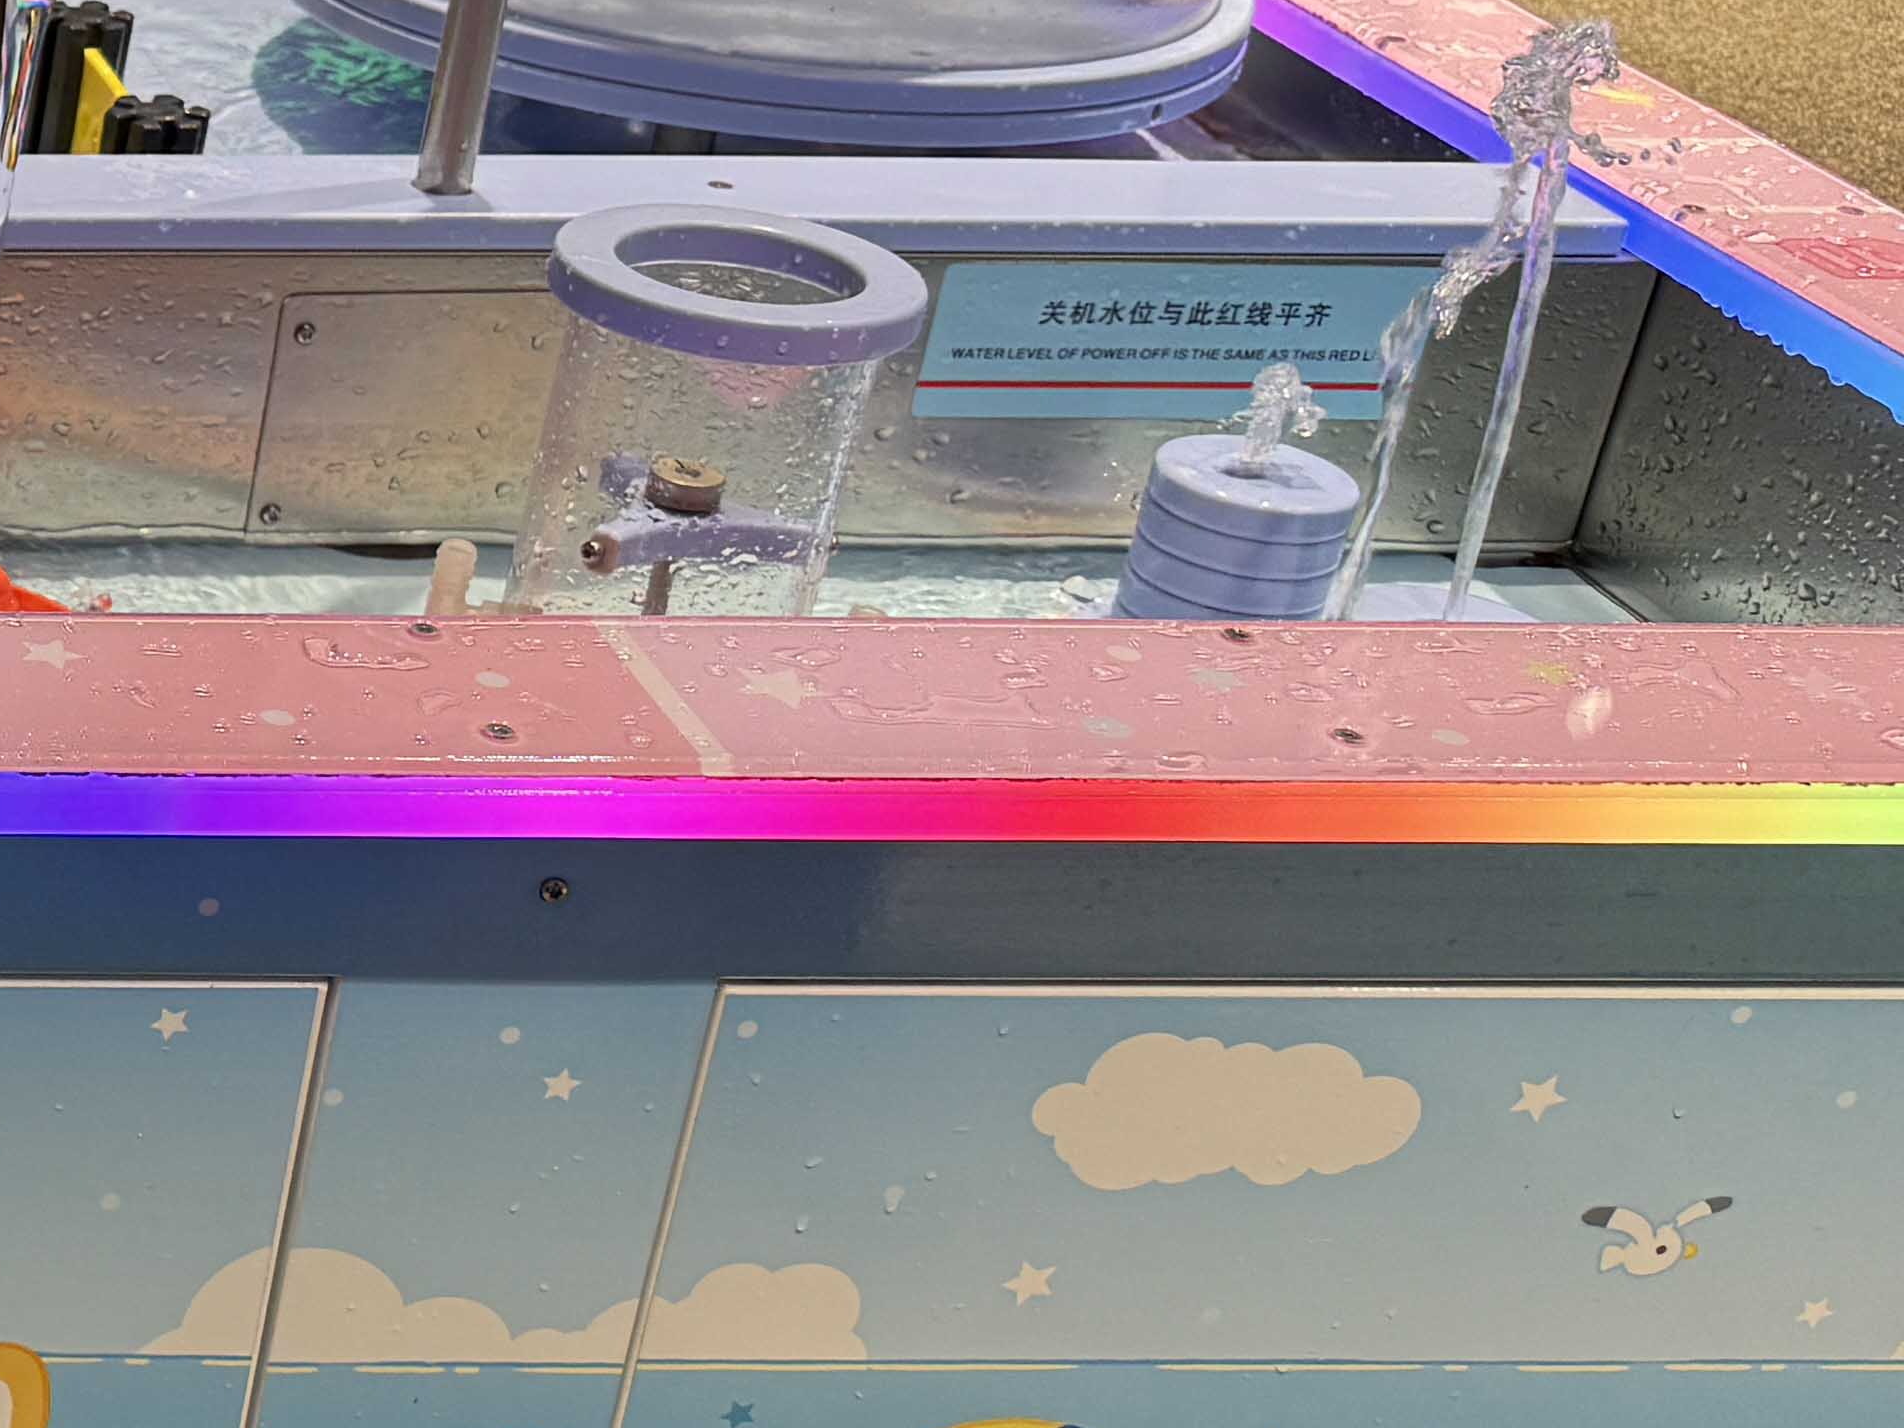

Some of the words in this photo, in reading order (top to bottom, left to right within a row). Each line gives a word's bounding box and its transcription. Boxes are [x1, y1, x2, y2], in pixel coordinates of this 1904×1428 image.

[1038, 300, 1333, 328] 关机水位与此红线平齐
[951, 347, 1006, 361] WATER
[1007, 347, 1053, 361] LEVEL
[1057, 347, 1080, 361] OF
[1080, 347, 1137, 361] POWER
[1139, 347, 1169, 361] OFF
[1173, 347, 1188, 361] IS
[1192, 347, 1223, 361] THE
[1223, 347, 1265, 361] SAME
[1268, 347, 1289, 361] AS
[1293, 347, 1326, 361] THIS
[1328, 347, 1360, 361] RED
